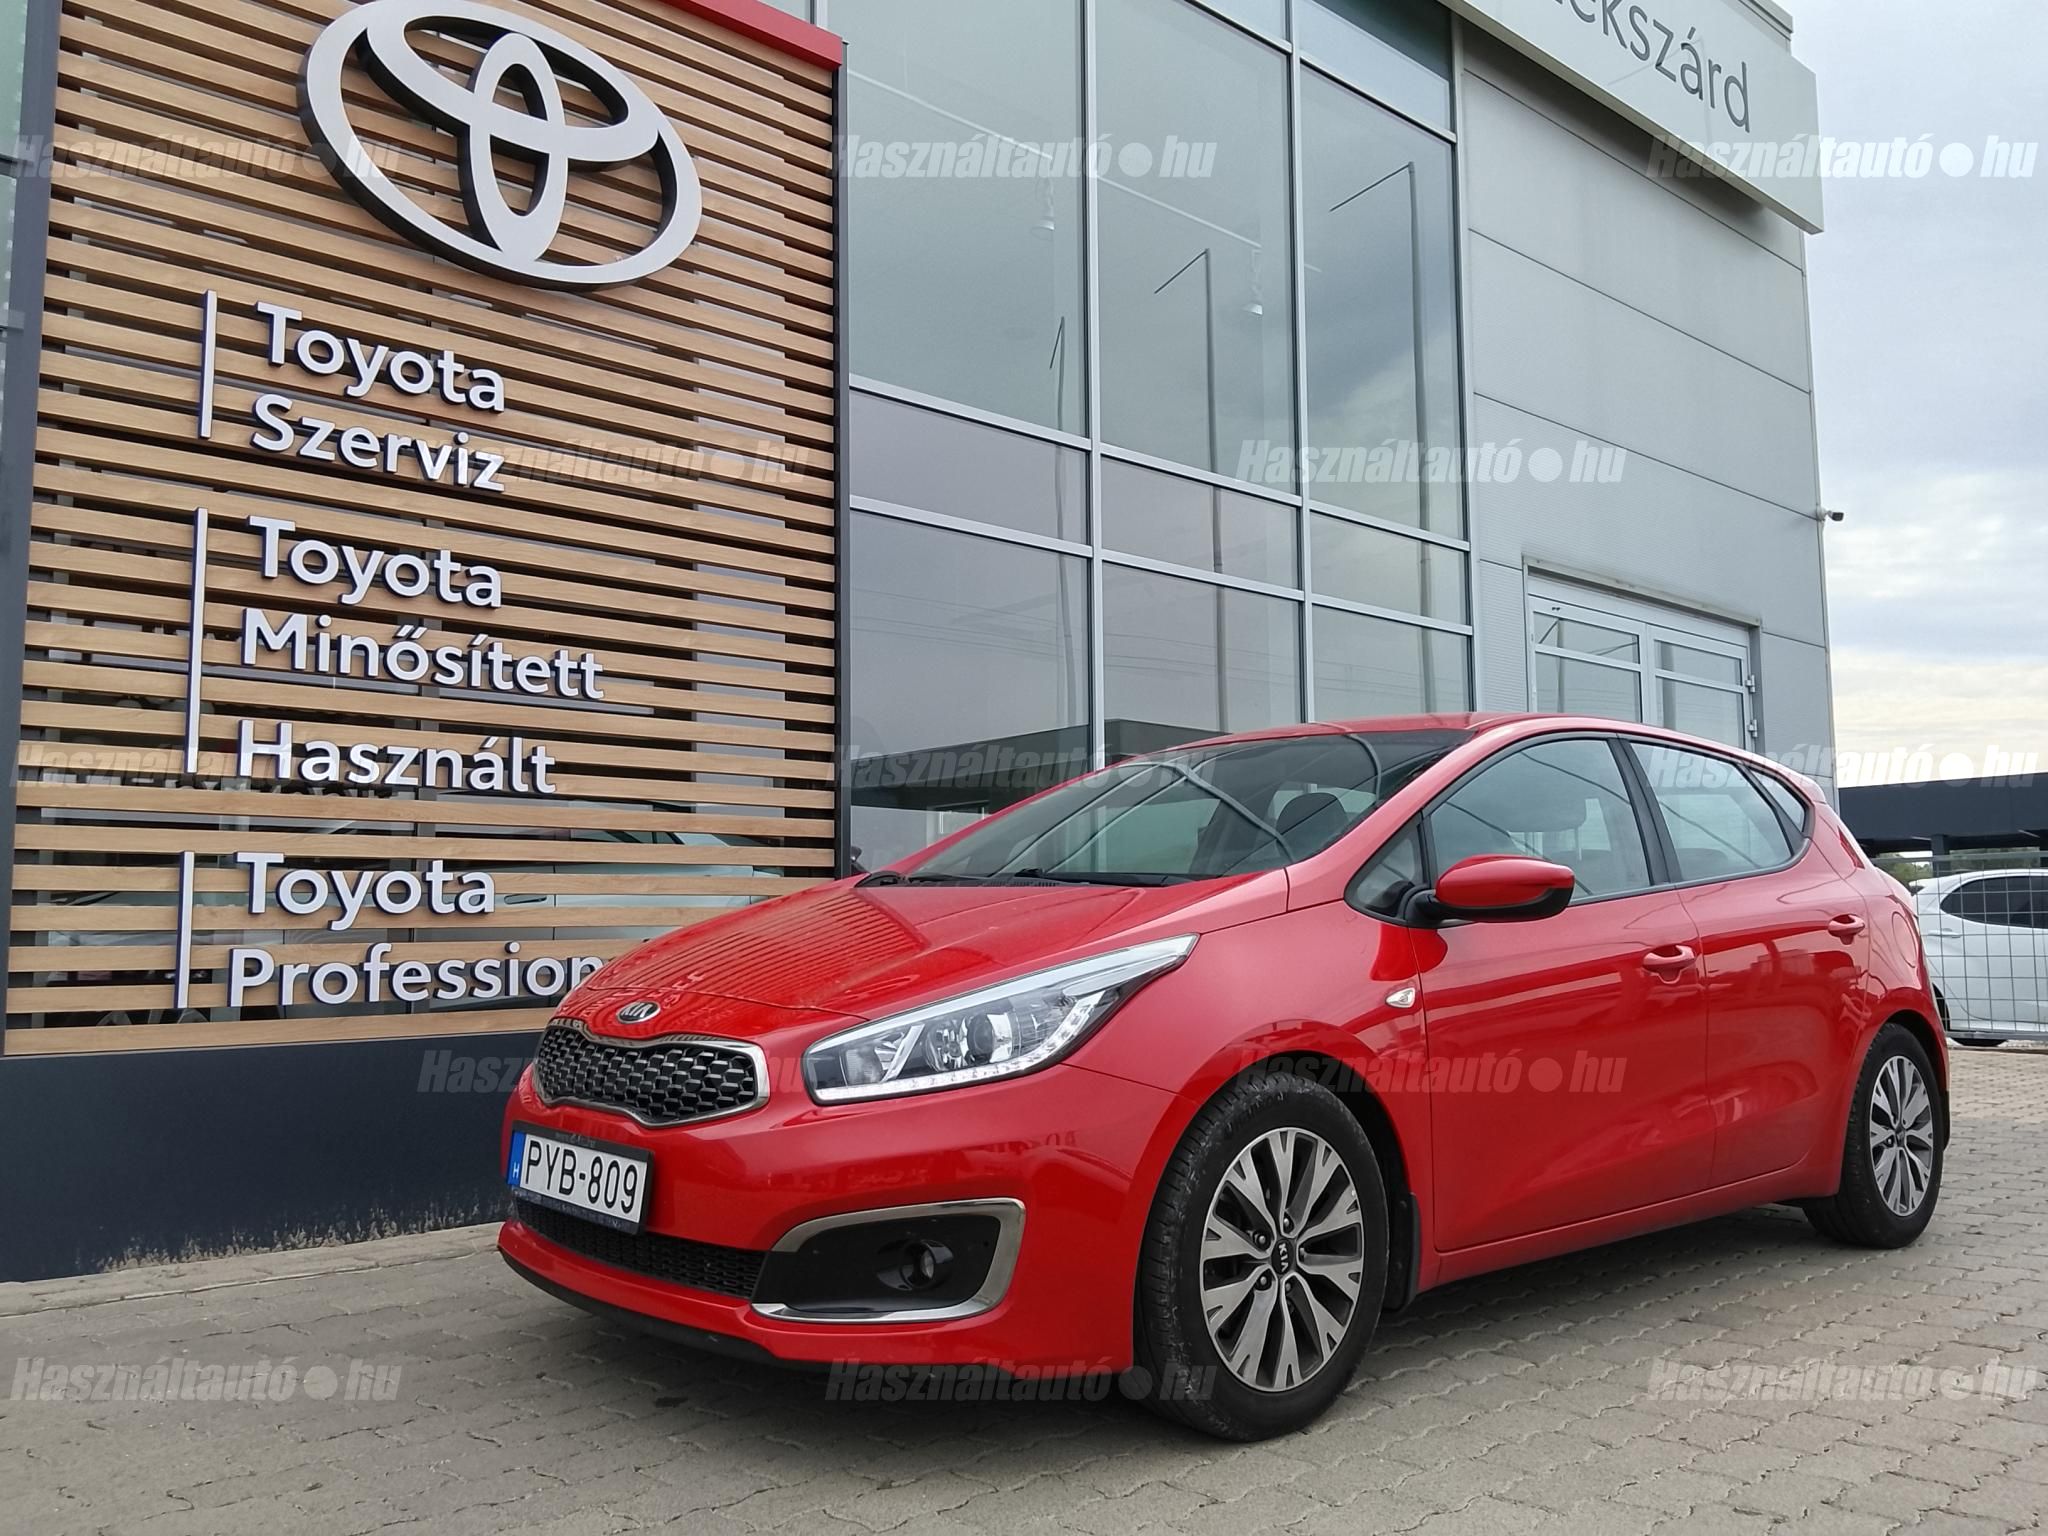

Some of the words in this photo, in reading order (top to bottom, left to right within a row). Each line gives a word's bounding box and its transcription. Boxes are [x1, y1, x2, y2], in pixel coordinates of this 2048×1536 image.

[256, 301, 505, 412] Toyota
[252, 394, 505, 491] Szerviz
[248, 515, 502, 608] Toyota
[242, 607, 605, 699] Minősített
[238, 719, 556, 794] Használt
[234, 851, 496, 932] Toyota
[621, 1001, 648, 1019] KIA
[512, 1162, 520, 1178] H
[525, 1139, 638, 1214] PYB-809
